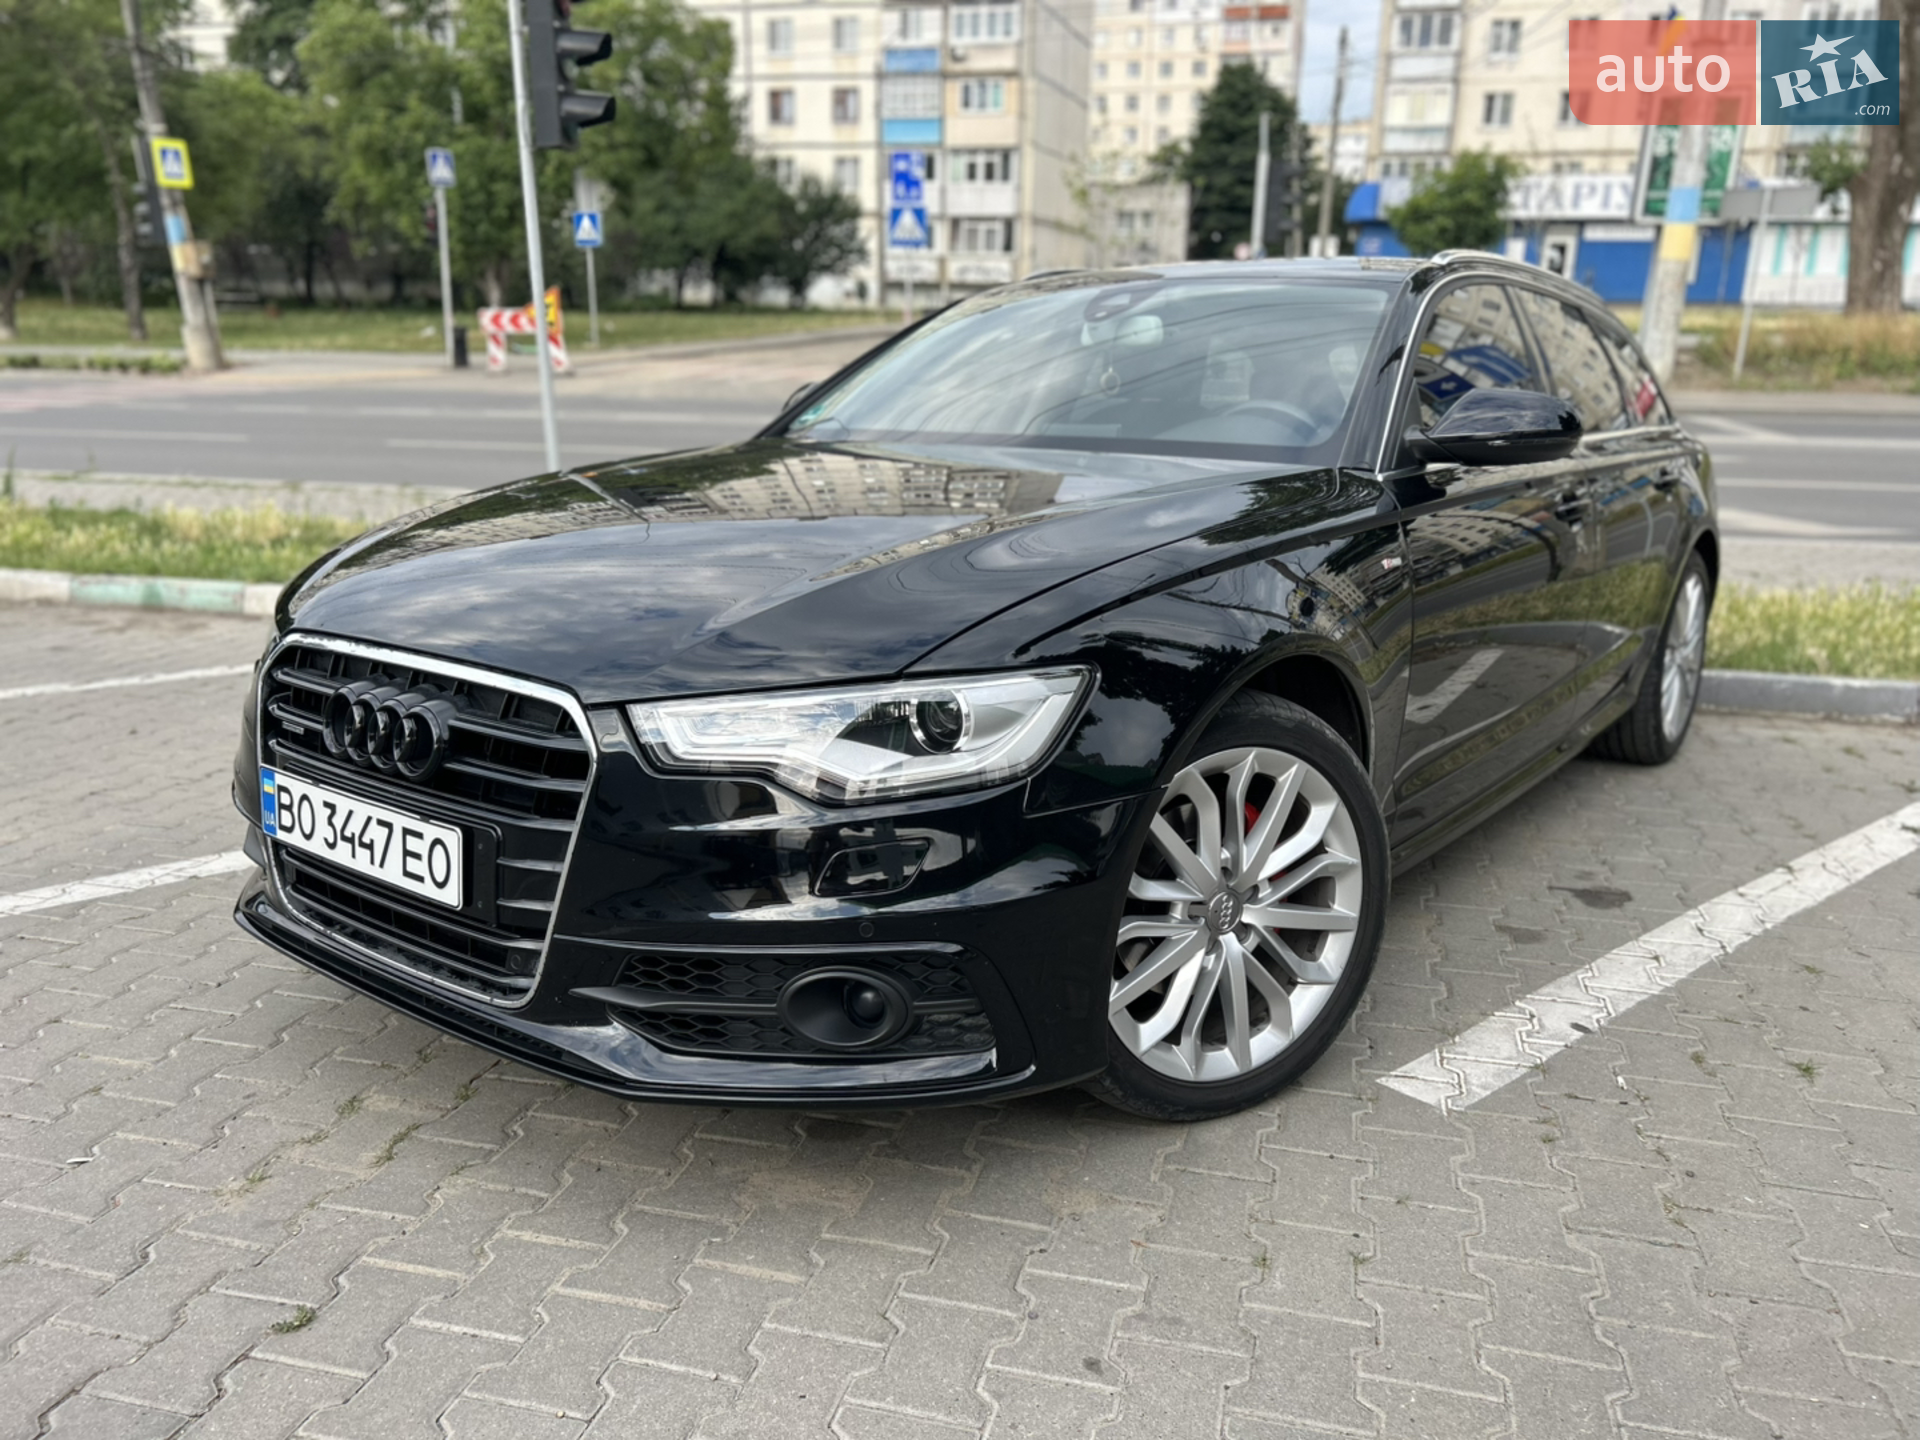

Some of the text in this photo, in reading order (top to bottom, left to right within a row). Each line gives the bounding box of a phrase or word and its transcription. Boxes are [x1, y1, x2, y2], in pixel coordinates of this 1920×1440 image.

[264, 809, 276, 827] UA
[276, 784, 452, 890] BO 3447 EO
